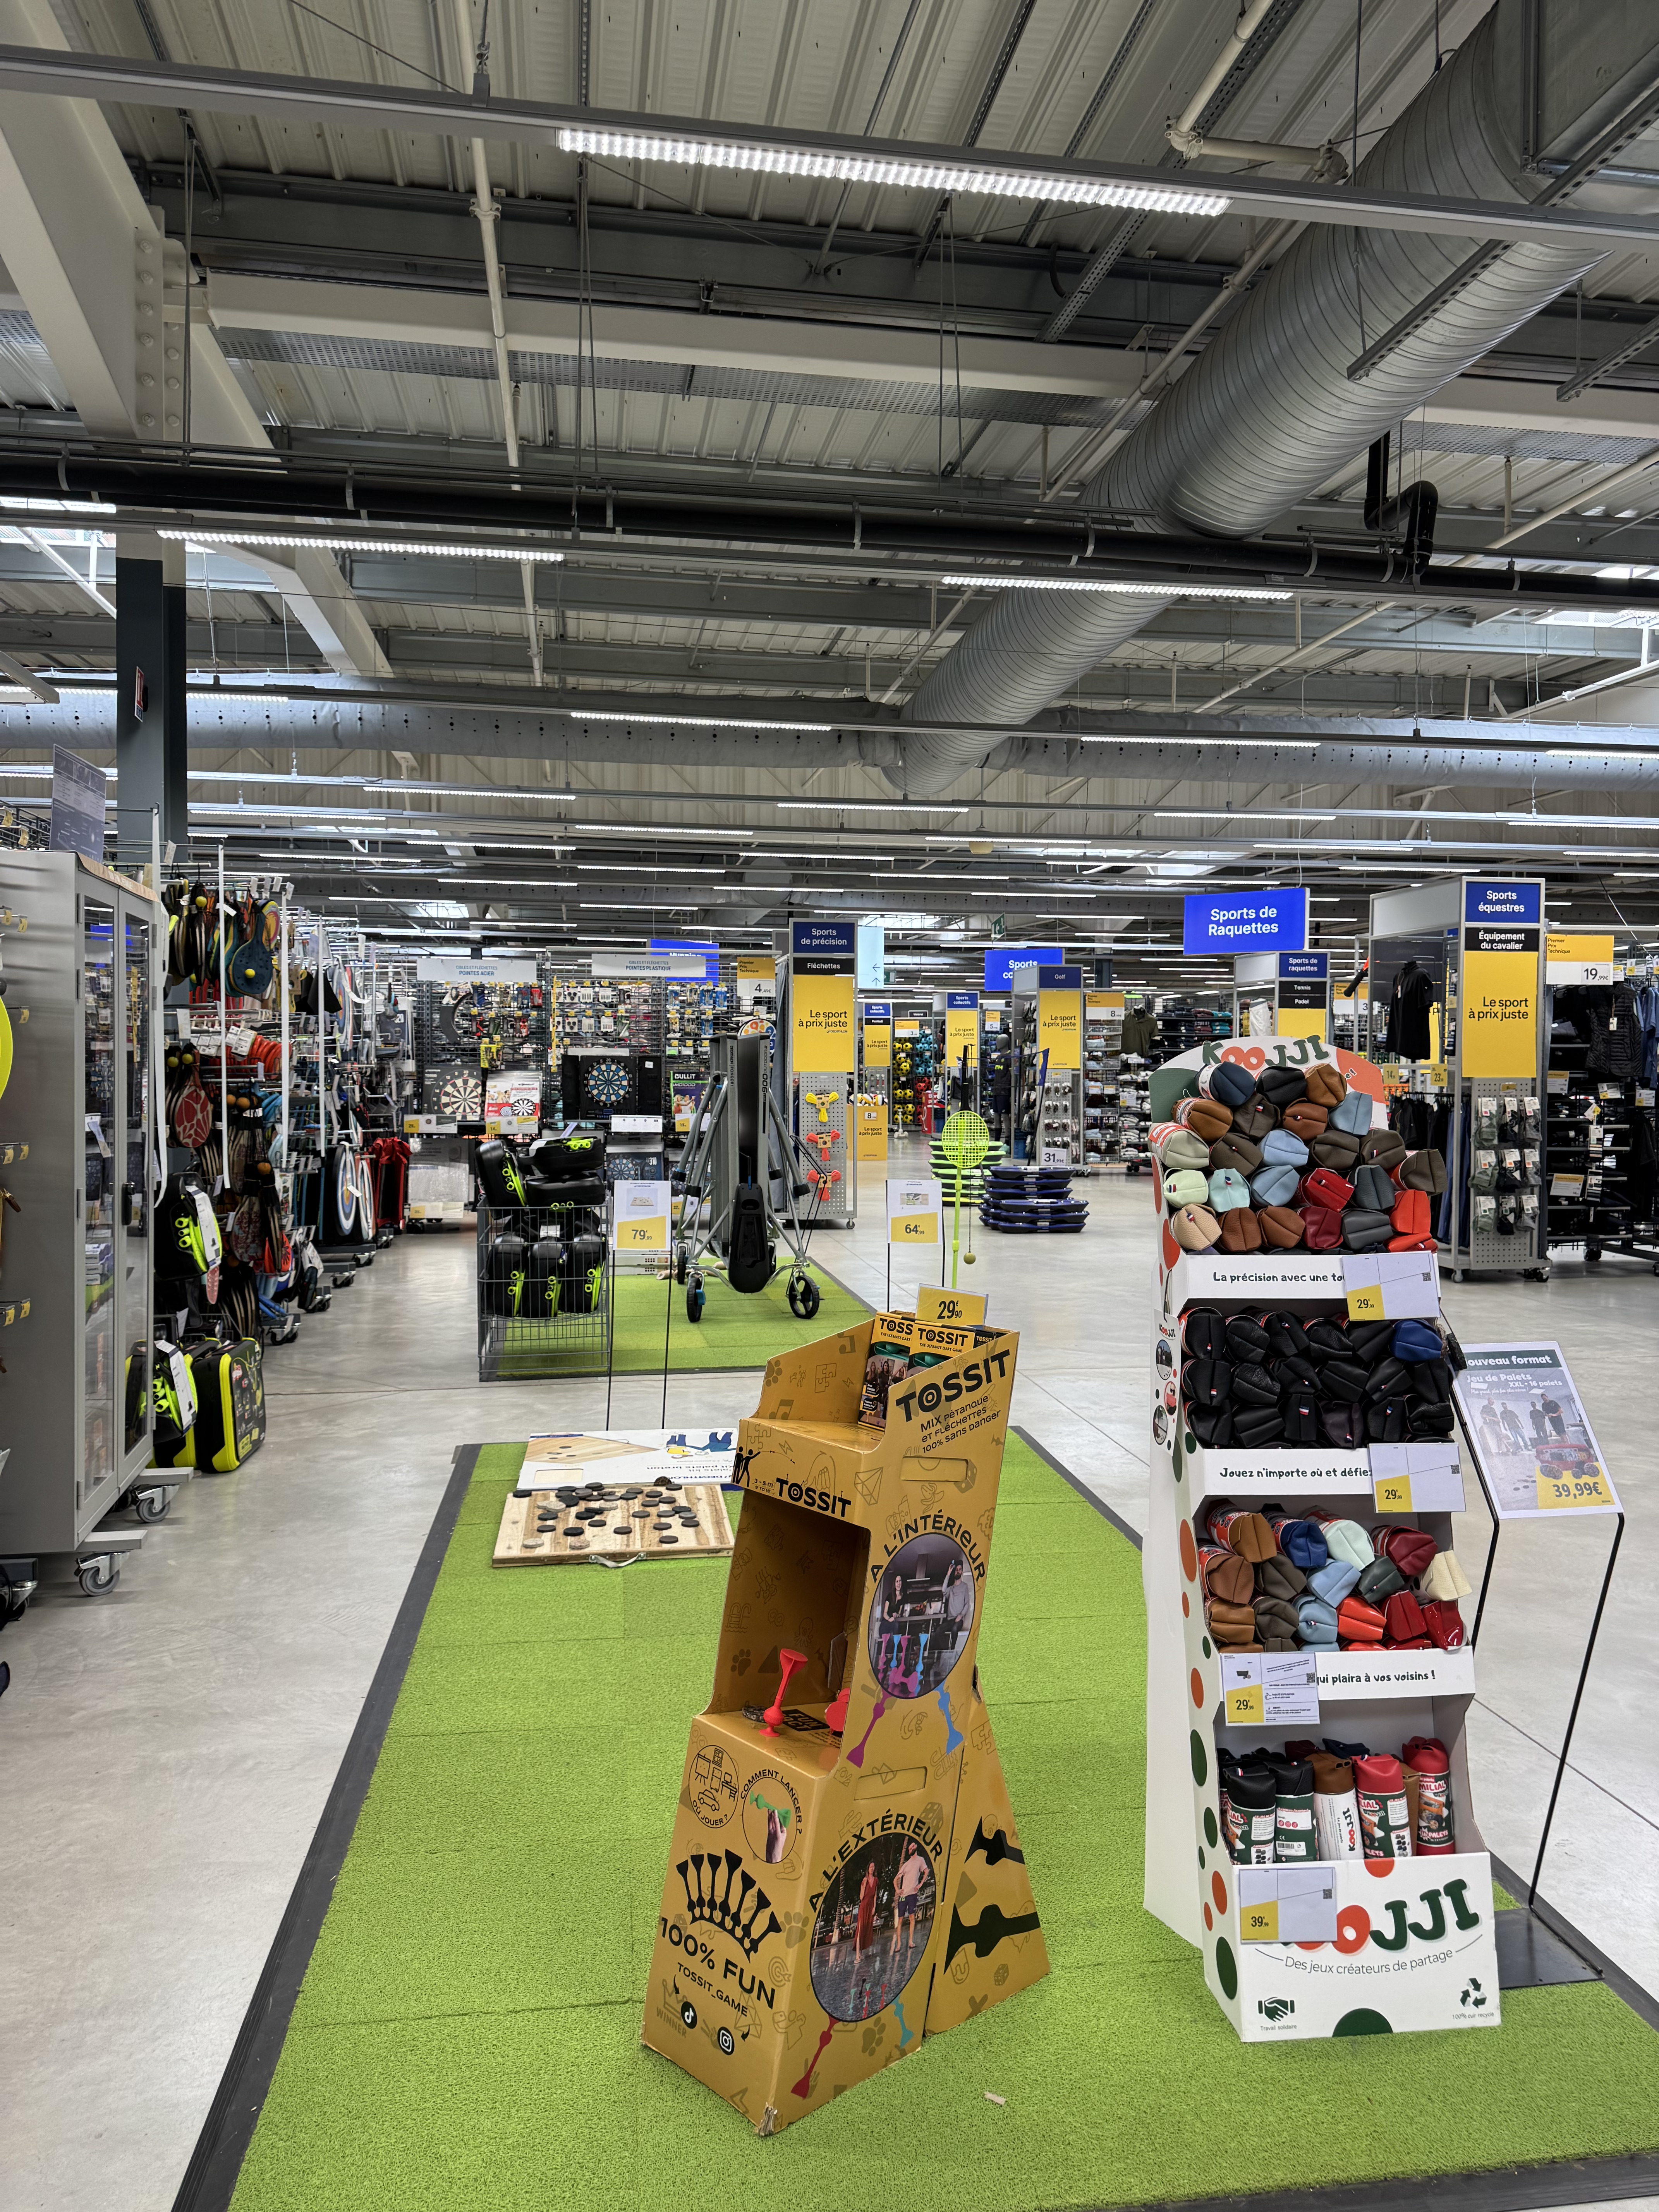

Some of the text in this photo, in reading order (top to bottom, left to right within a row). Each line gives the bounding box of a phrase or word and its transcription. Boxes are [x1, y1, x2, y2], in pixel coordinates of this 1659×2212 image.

[1486, 890, 1517, 902] Sports
[1211, 906, 1277, 923] Sports de
[1478, 902, 1525, 914] équestres
[811, 928, 836, 937] Sports
[1208, 922, 1279, 938] Raquettes
[1479, 930, 1525, 941] Équipement
[812, 937, 847, 946] précision
[1492, 941, 1523, 950] cavalier
[1008, 960, 1038, 970] Sports
[1483, 996, 1528, 1010] Le sport
[810, 1009, 847, 1020] Le sport
[1468, 1008, 1528, 1022] à prix juste
[798, 1018, 847, 1029] à prix juste
[1202, 1034, 1329, 1070] KOOJJI
[1213, 1271, 1227, 1282] La
[1230, 1273, 1278, 1284] précision
[879, 1317, 914, 1336] TOSS
[917, 1328, 968, 1346] TOSSIT
[1467, 1355, 1552, 1366] ouveau format
[1499, 1373, 1532, 1381] Palets
[895, 1349, 1010, 1423] TOSSIT
[920, 1415, 942, 1432] MIX
[922, 1439, 943, 1453] 100%
[945, 1427, 967, 1443] sans
[1219, 1467, 1254, 1478] Jouez
[1257, 1468, 1308, 1479] n'importe
[1310, 1468, 1322, 1477] où
[1325, 1469, 1338, 1477] et
[776, 1476, 852, 1518] TOSSIT
[1553, 1481, 1602, 1499] 39,99€
[870, 1564, 884, 1583] A
[1331, 1673, 1362, 1686] plaira
[1364, 1673, 1370, 1683] à
[1394, 1671, 1429, 1681] voisins
[1431, 1669, 1436, 1680] !
[788, 1713, 822, 1727] FUN
[740, 1769, 780, 1800] COMMENT
[780, 1775, 802, 1824] LANCER
[692, 1800, 701, 1815] OÙ
[700, 1814, 724, 1826] JOUER
[1343, 1807, 1356, 1852] KOOJJI
[808, 1808, 943, 1913] A L'EXTÉRIEUR
[1279, 1878, 1480, 1954] OJJI
[661, 1917, 776, 2010] 100% FUN
[1285, 1948, 1453, 1975] Des jeux créateurs de partage
[677, 1961, 748, 2018] TOSSIT_GAME
[656, 2006, 687, 2039] WINNER
